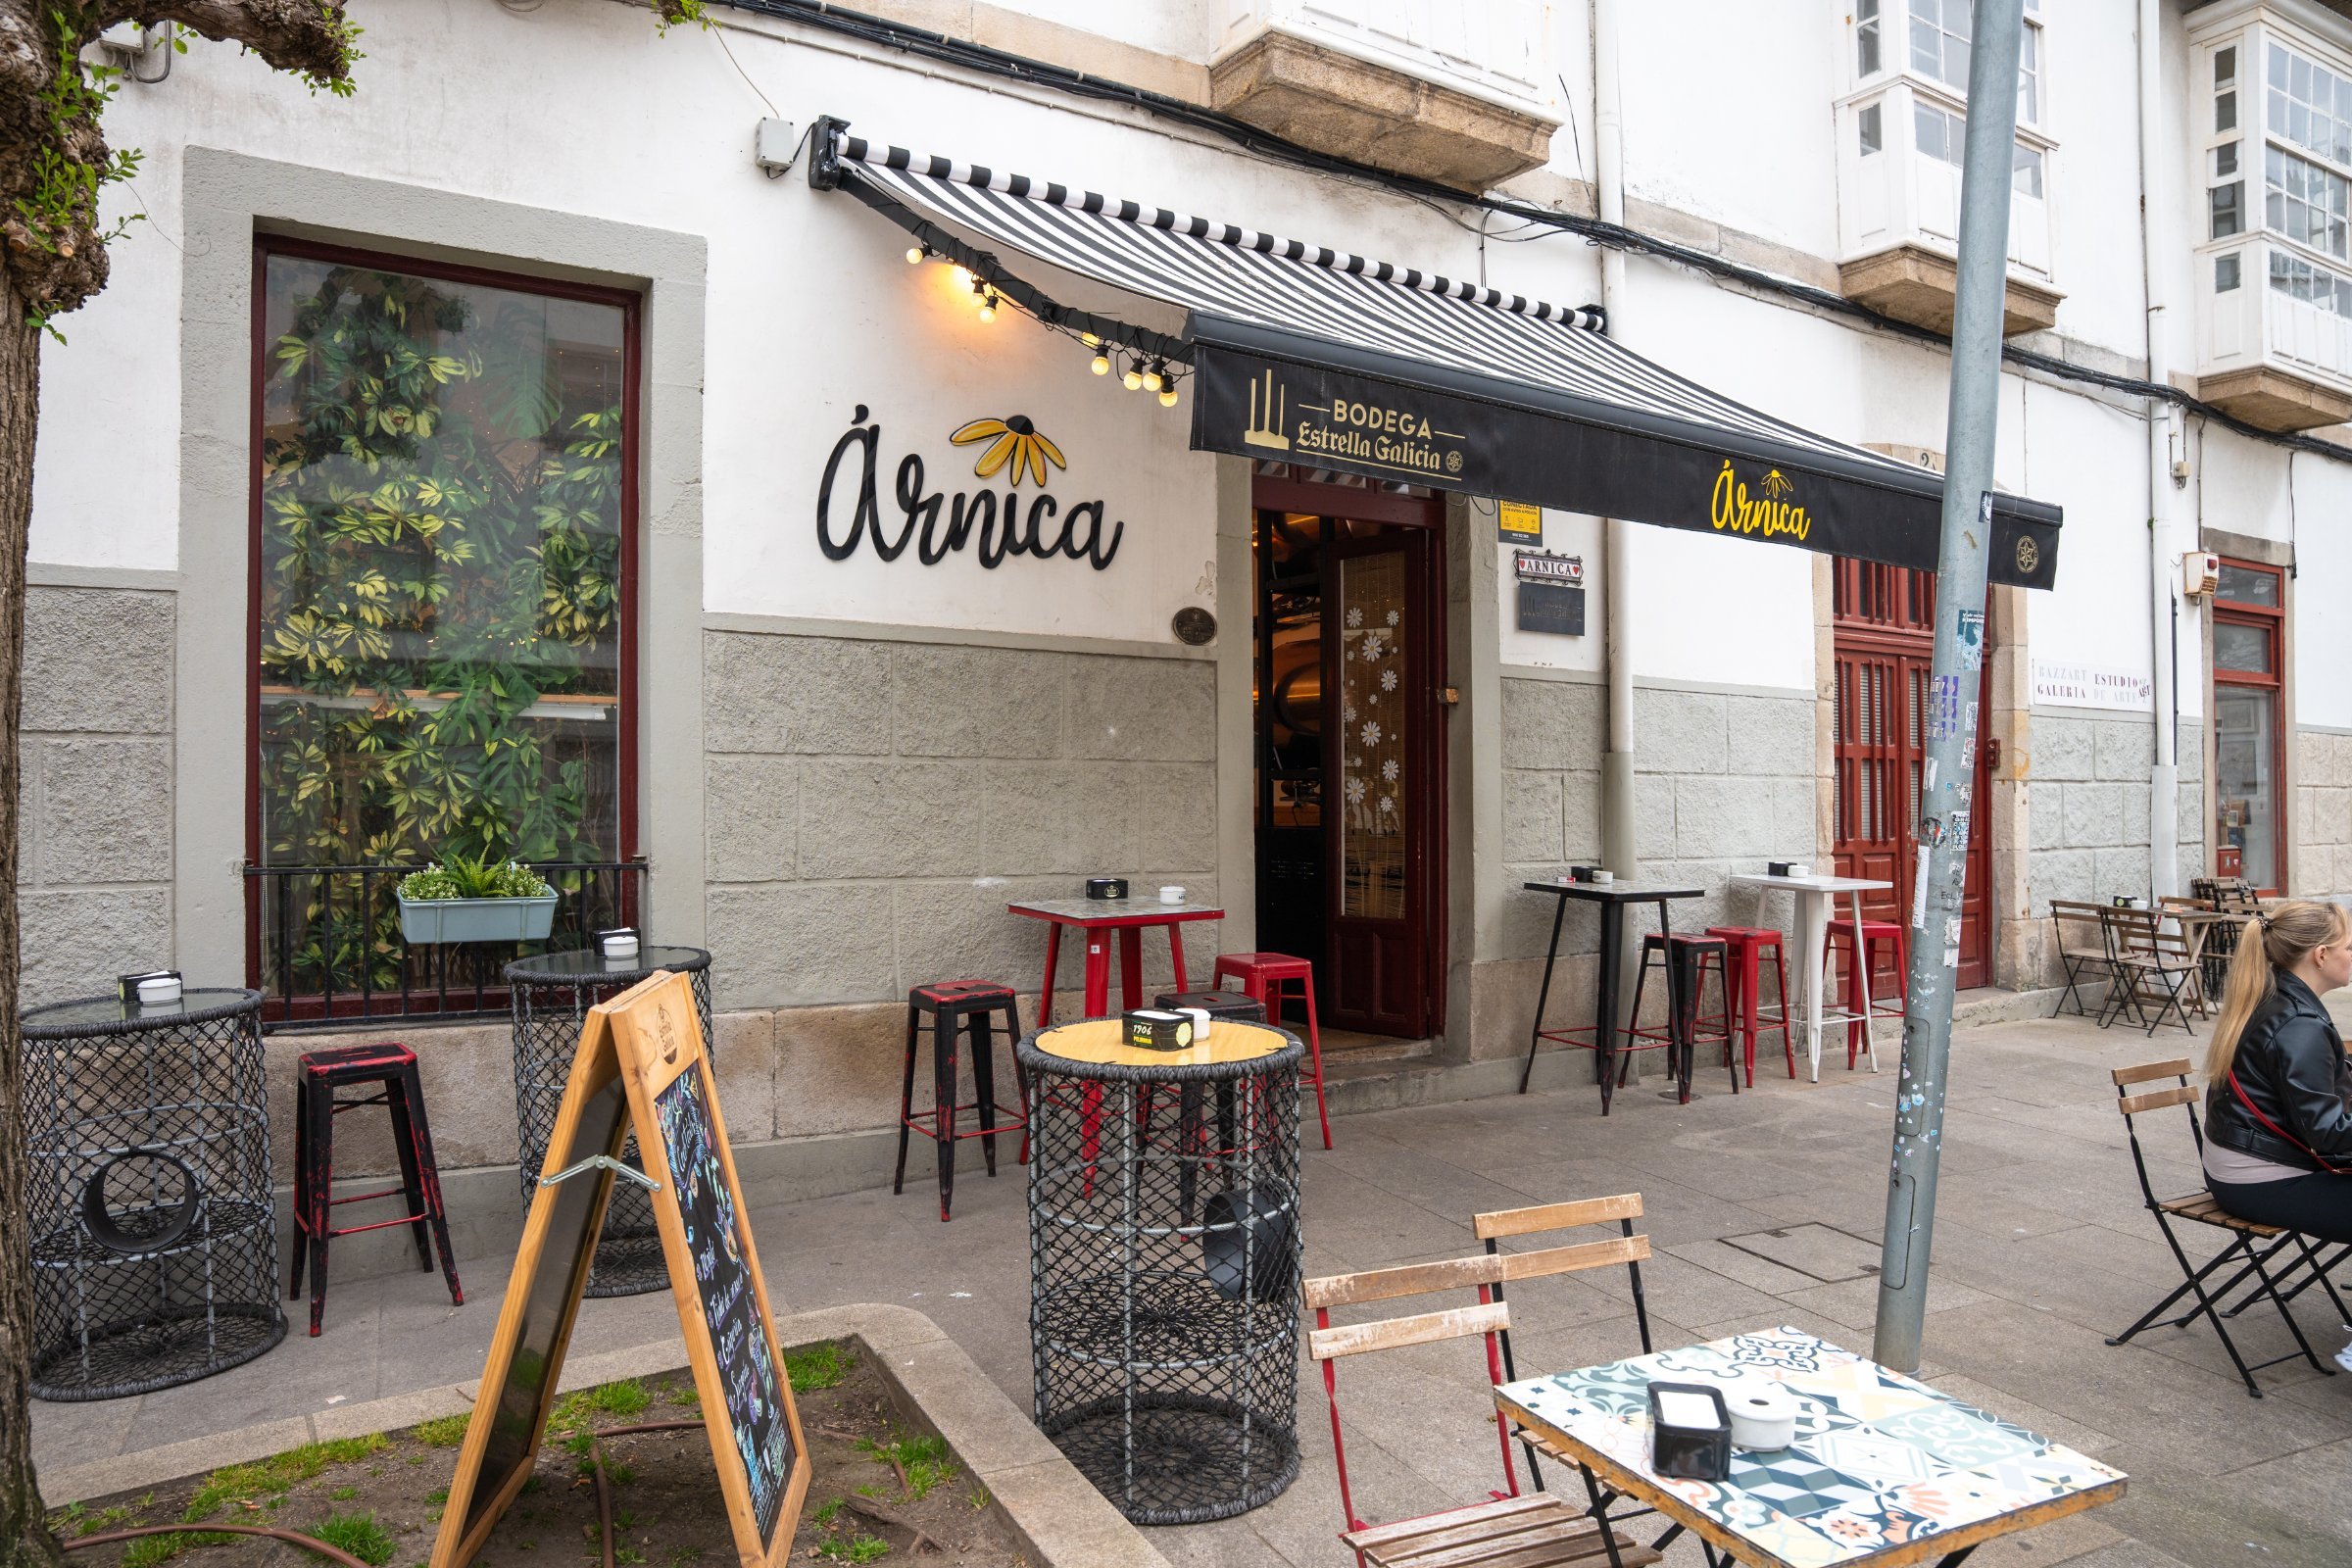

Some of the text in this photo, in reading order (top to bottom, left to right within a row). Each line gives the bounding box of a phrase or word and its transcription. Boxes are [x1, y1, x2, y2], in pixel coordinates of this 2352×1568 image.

[1334, 399, 1432, 439] BODEGA
[1297, 420, 1371, 458] Estrella
[1374, 435, 1441, 470] Galicia
[816, 404, 1125, 571] Árnica
[1711, 459, 1811, 541] Árnica
[1527, 559, 1573, 576] ARNICA
[2094, 673, 2138, 688] ESTUDIO
[1133, 1024, 1152, 1036] 1906
